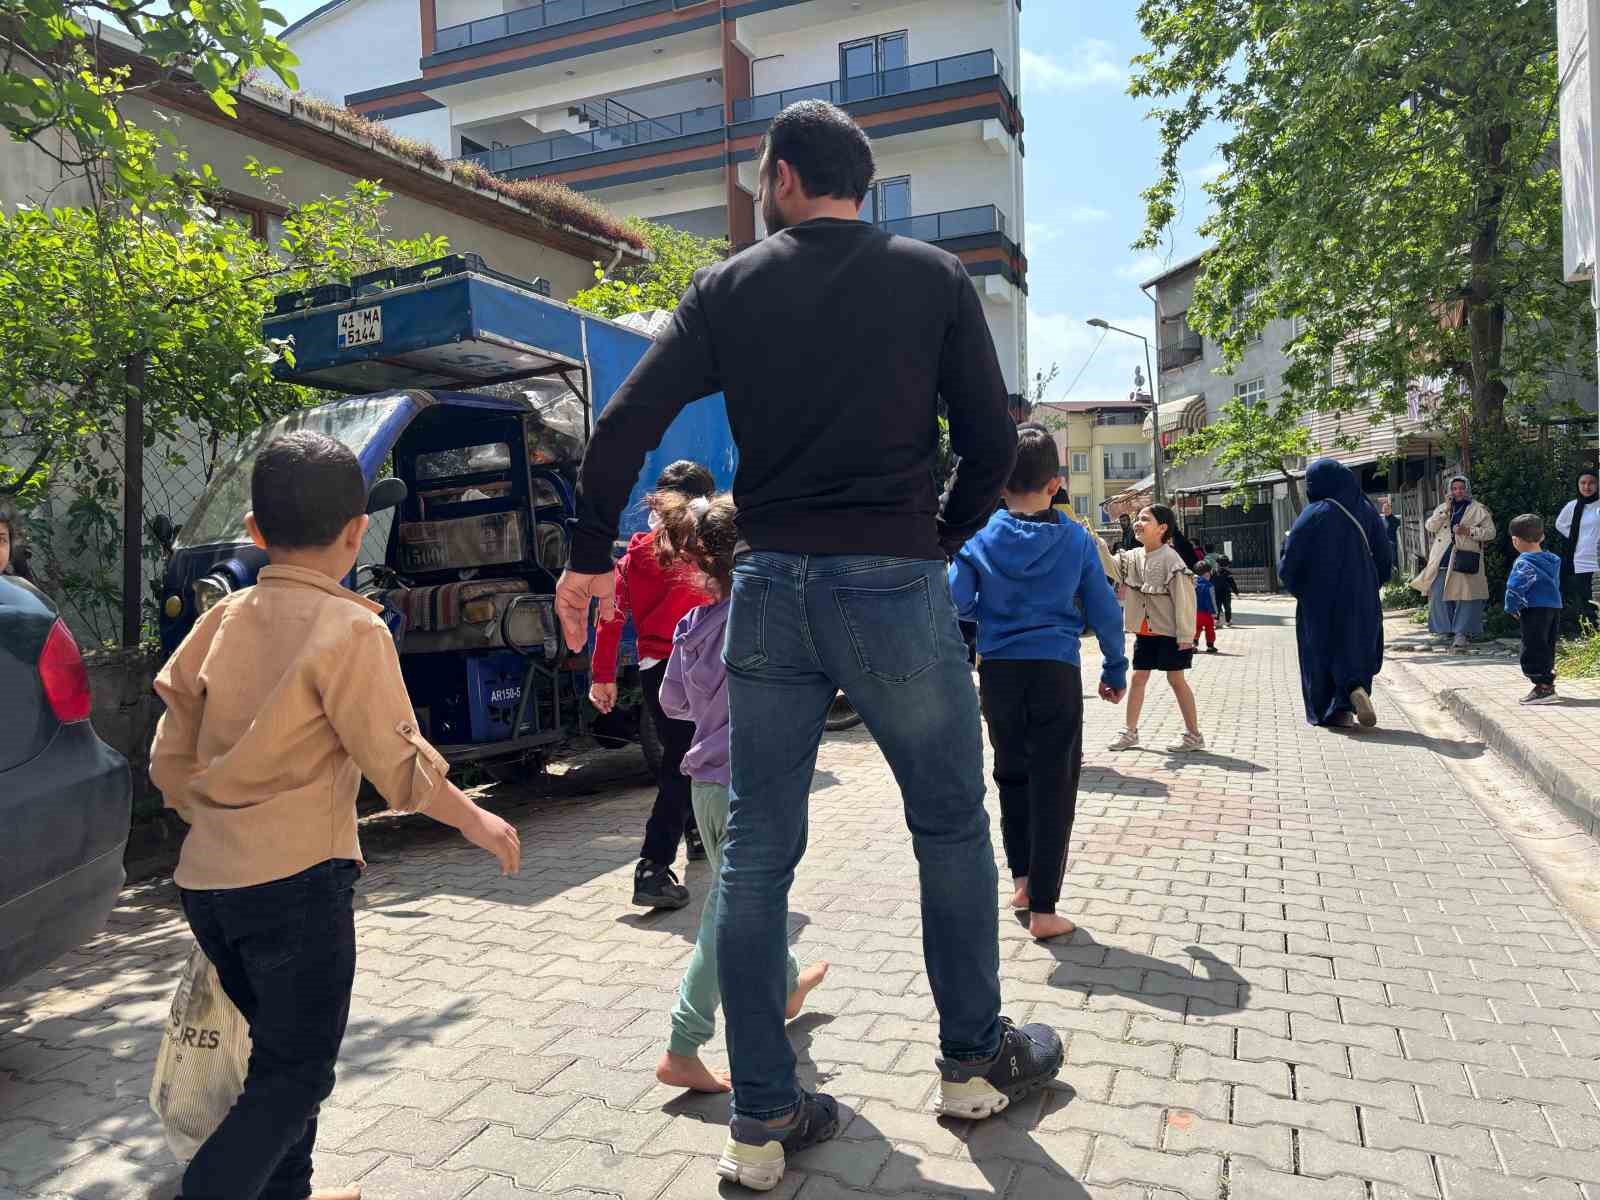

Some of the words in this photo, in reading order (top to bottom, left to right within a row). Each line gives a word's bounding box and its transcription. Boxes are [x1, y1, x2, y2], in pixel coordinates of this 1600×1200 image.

[341, 314, 355, 329] 41
[363, 308, 380, 325] MA
[347, 326, 376, 344] 5144
